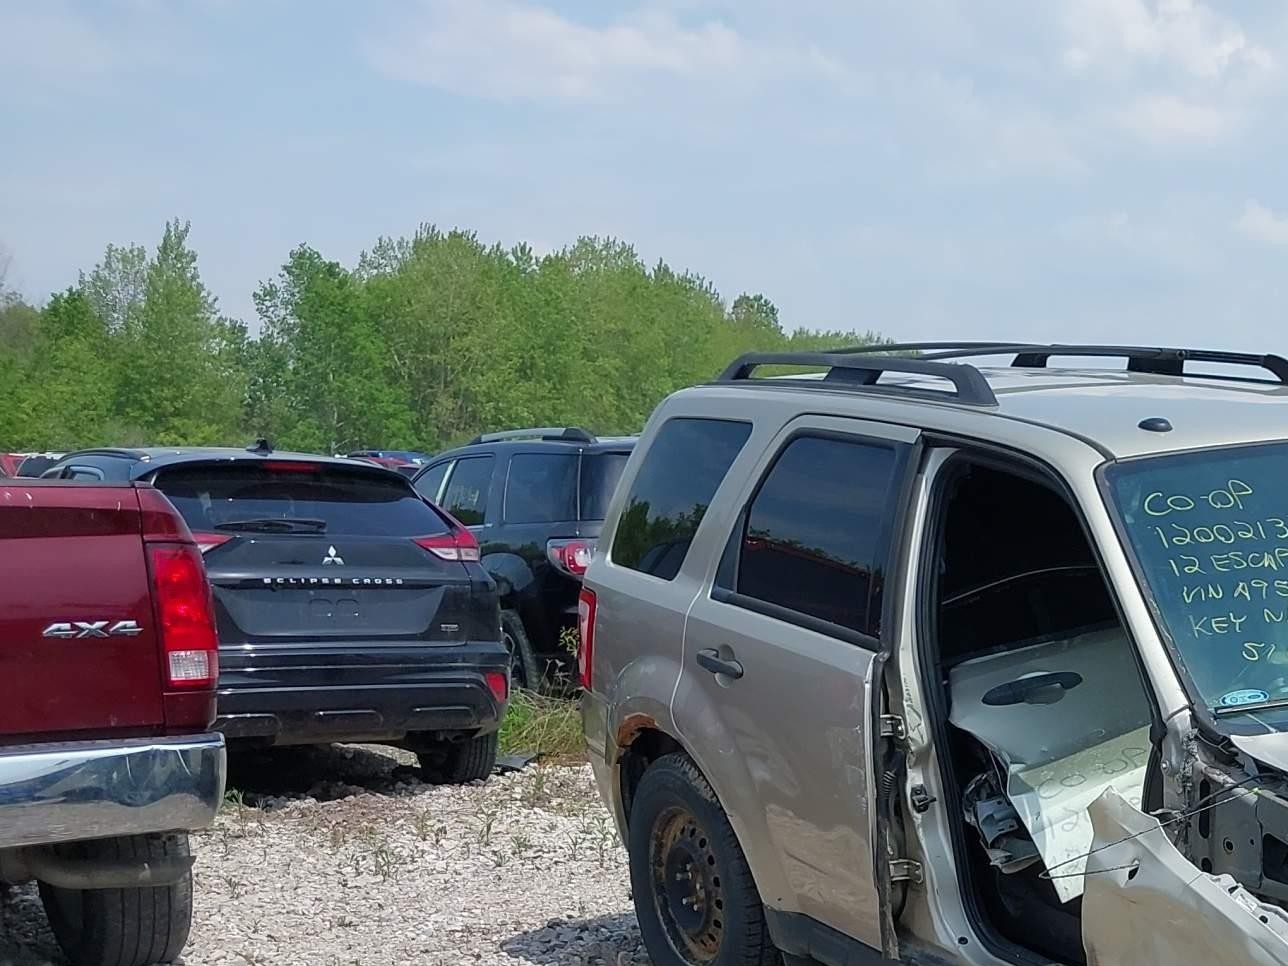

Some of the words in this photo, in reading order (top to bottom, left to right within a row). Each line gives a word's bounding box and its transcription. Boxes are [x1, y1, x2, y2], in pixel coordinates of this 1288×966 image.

[1168, 554, 1207, 577] 12
[263, 577, 343, 585] ECLIPSE
[352, 577, 404, 585] CROSS
[1182, 583, 1223, 604] VIN
[1188, 611, 1248, 639] KEY
